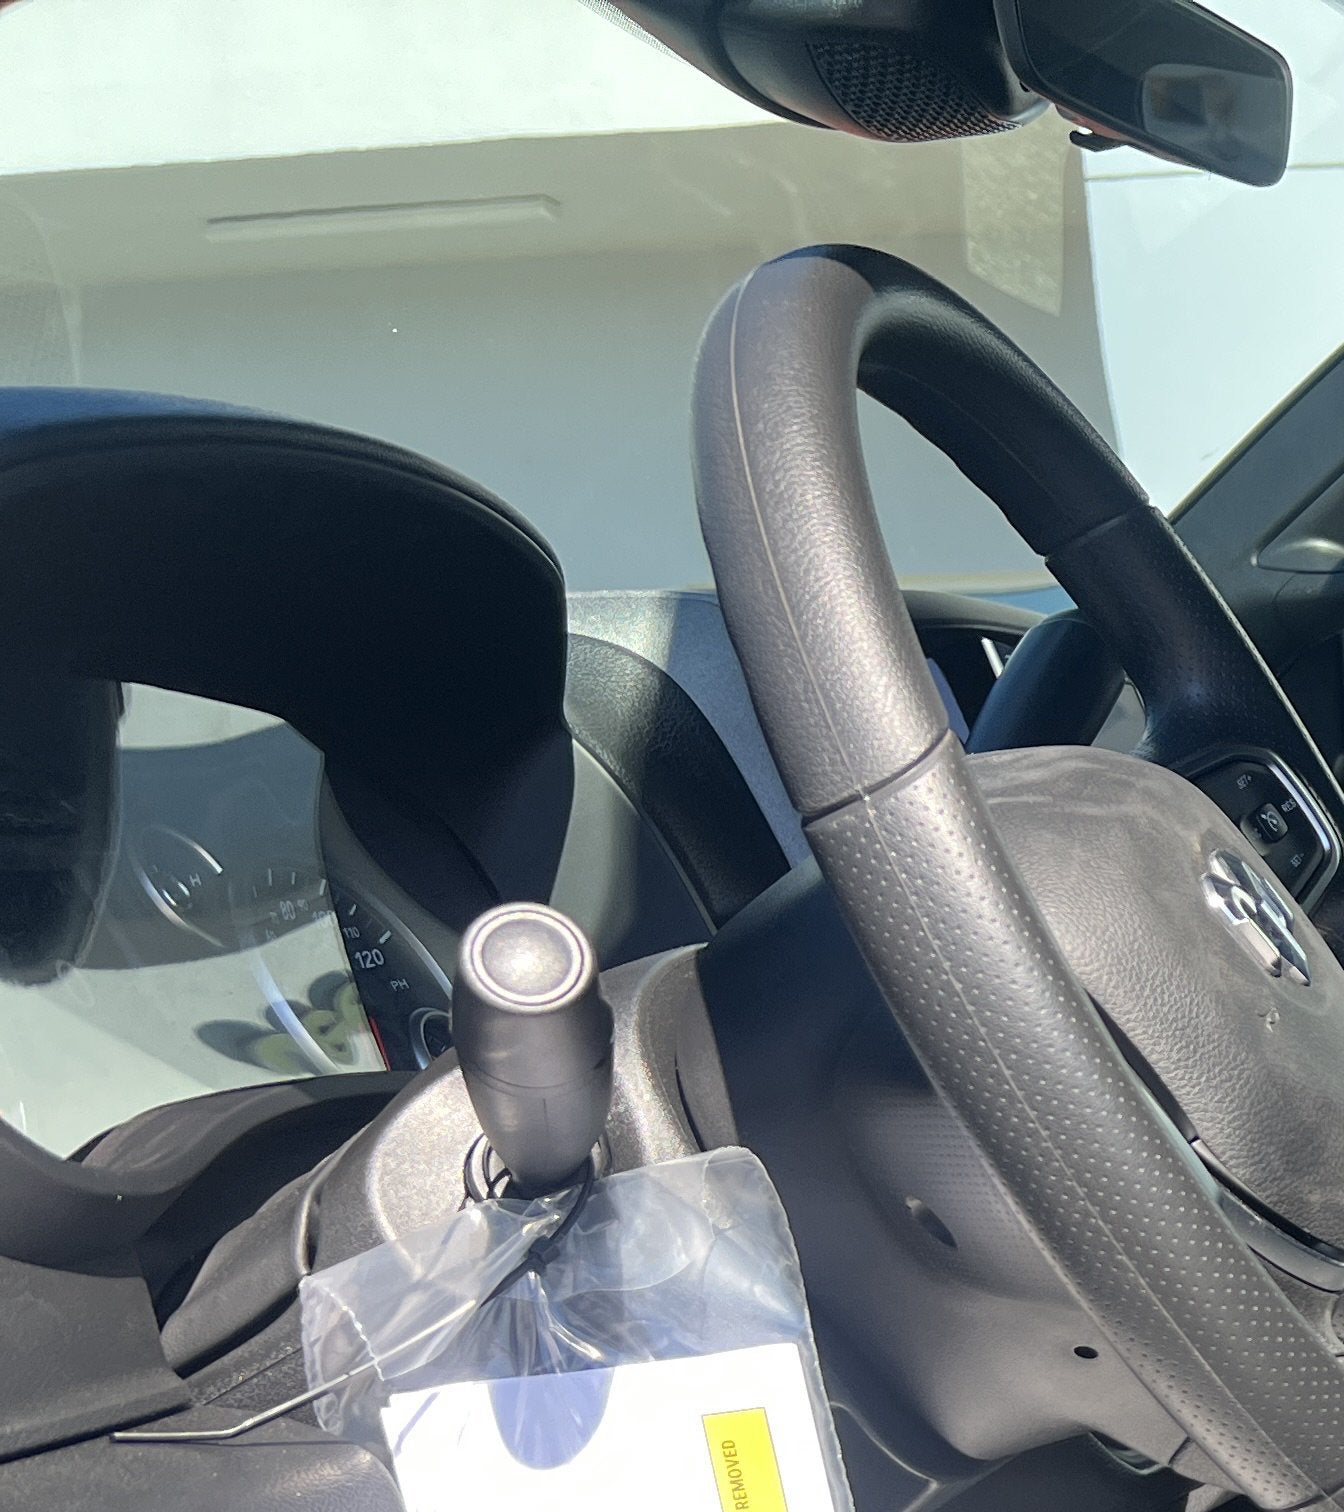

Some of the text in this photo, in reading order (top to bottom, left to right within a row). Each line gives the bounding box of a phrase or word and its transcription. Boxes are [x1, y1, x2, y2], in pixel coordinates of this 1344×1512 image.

[280, 900, 297, 921] 80
[342, 926, 361, 939] 110
[354, 948, 385, 969] 120
[721, 1439, 751, 1511] REMOVED
